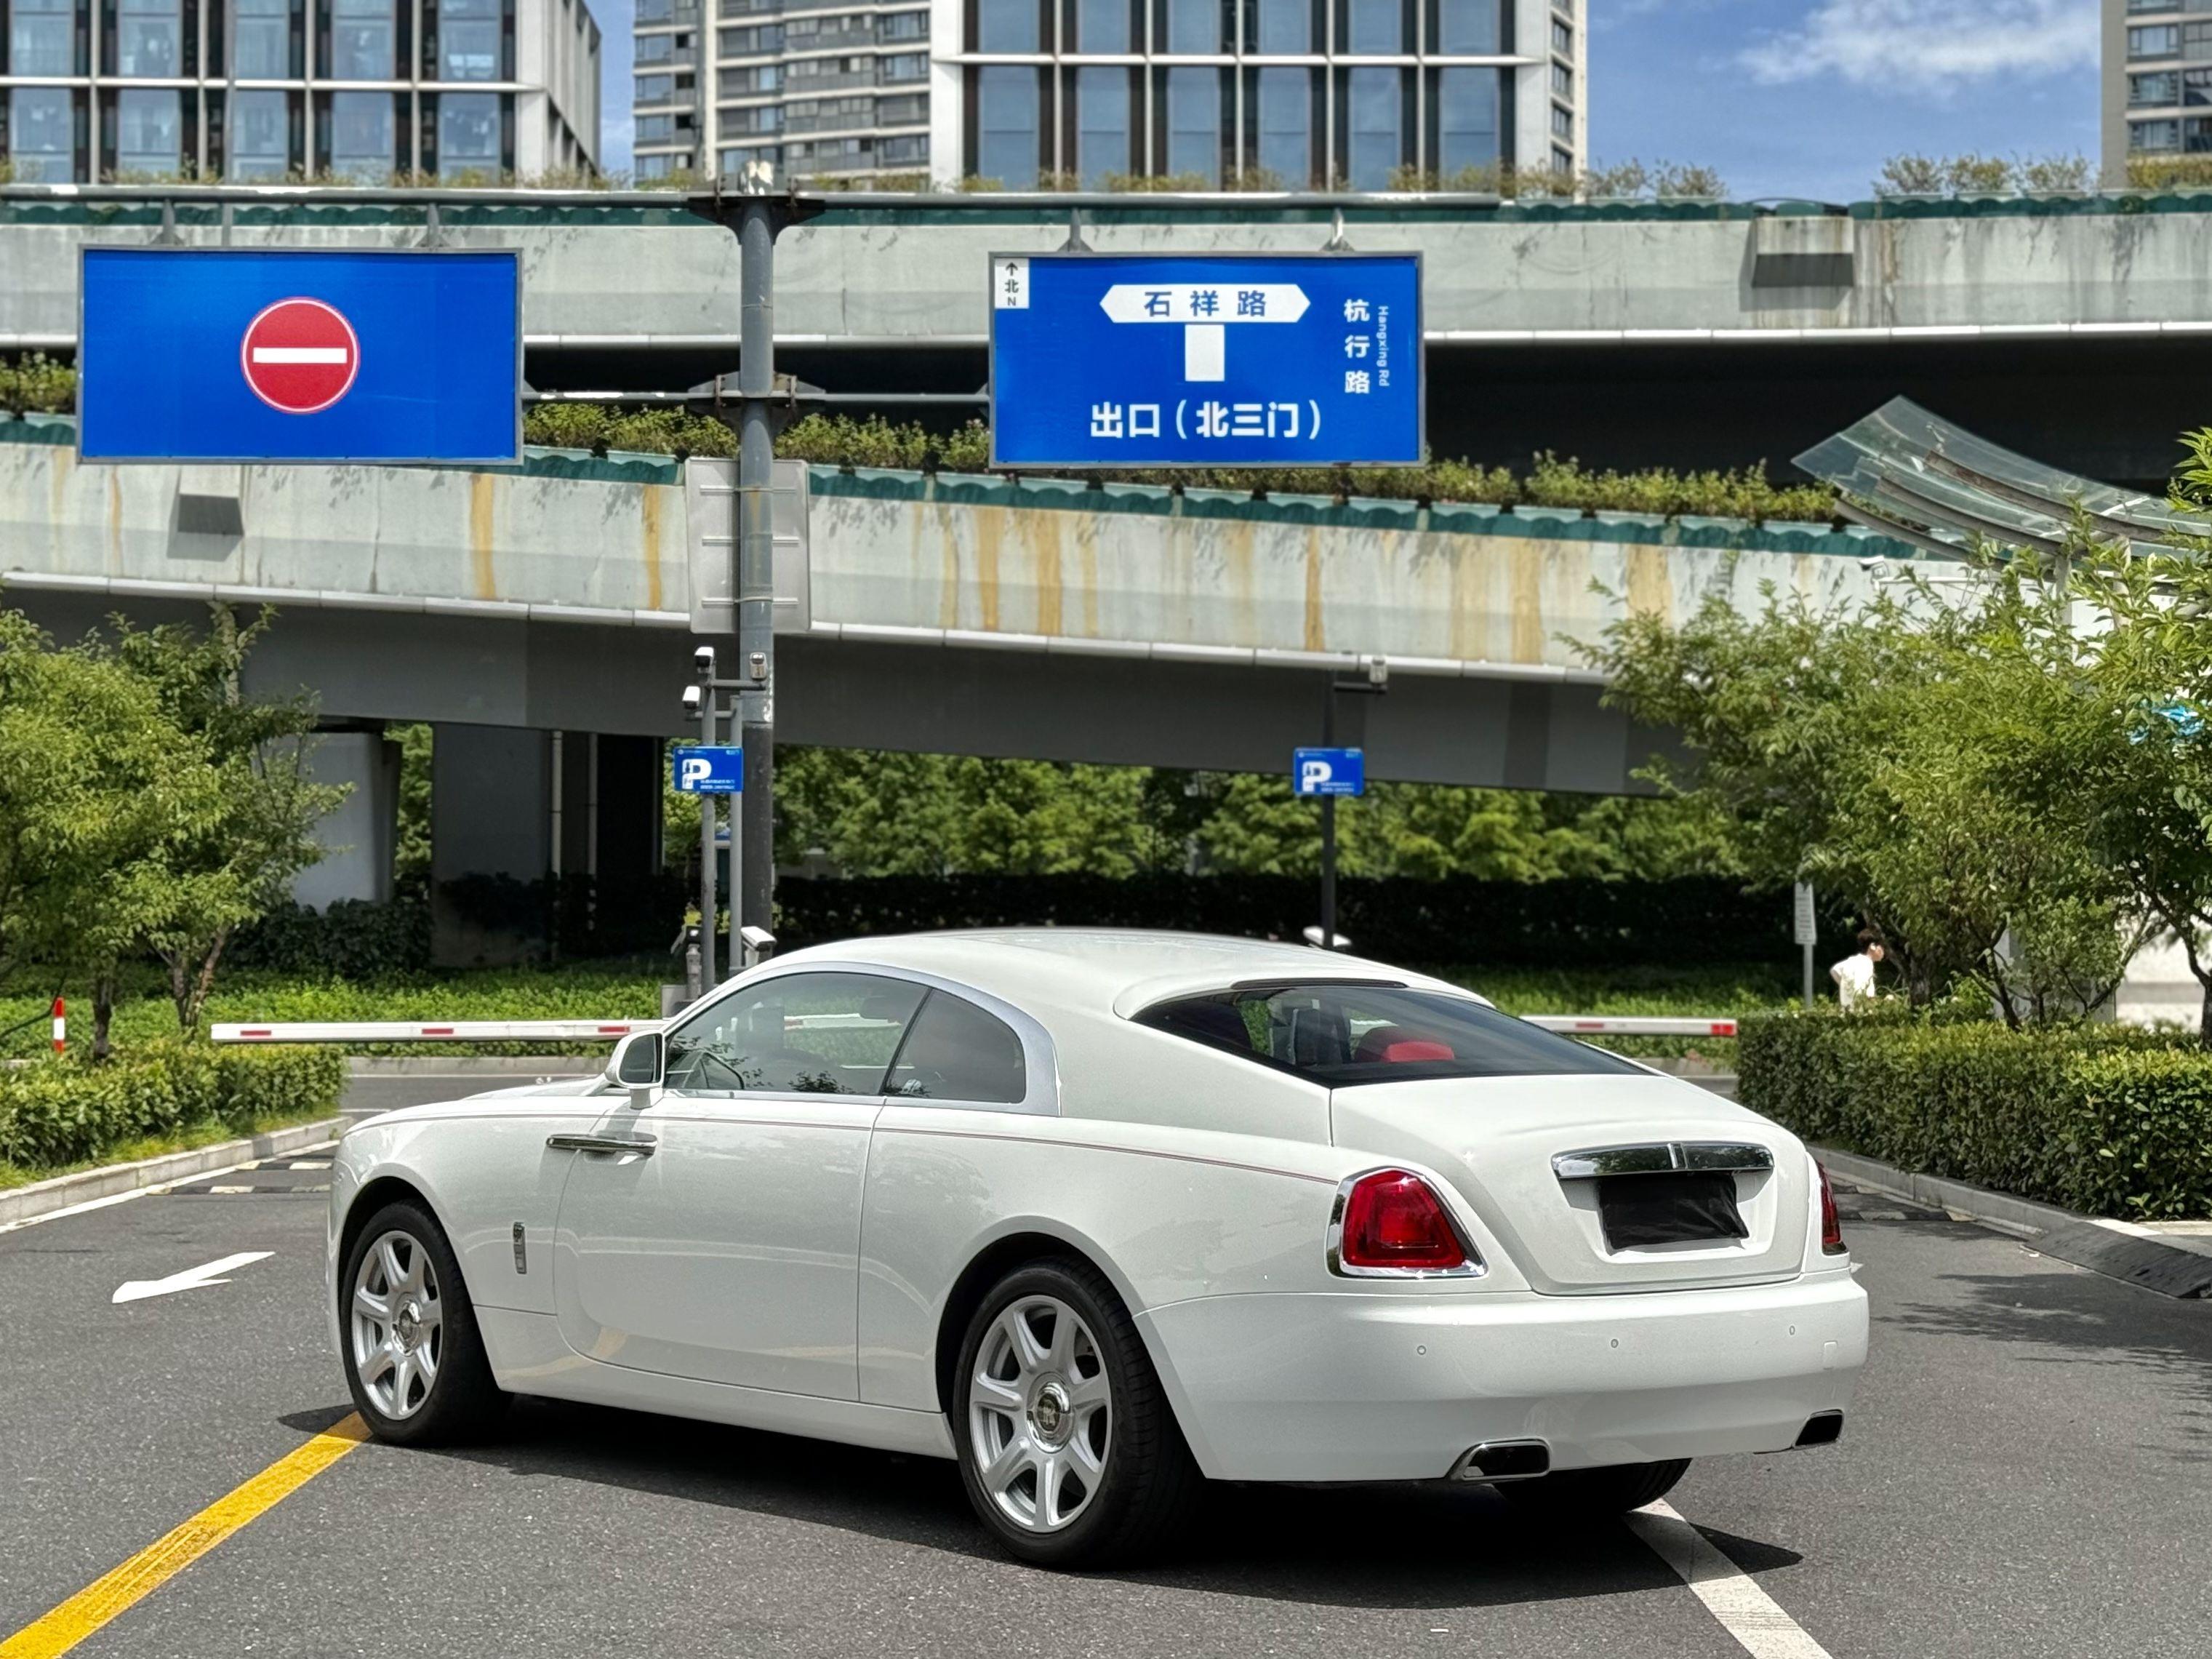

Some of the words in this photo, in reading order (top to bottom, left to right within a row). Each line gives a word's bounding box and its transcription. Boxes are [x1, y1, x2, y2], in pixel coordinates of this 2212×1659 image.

[1004, 279, 1019, 293] 北
[1007, 296, 1017, 306] N
[1144, 290, 1267, 317] 石祥路
[1344, 299, 1370, 394] 杭行路
[1377, 305, 1390, 367] Hangxing
[1378, 369, 1390, 387] Rd
